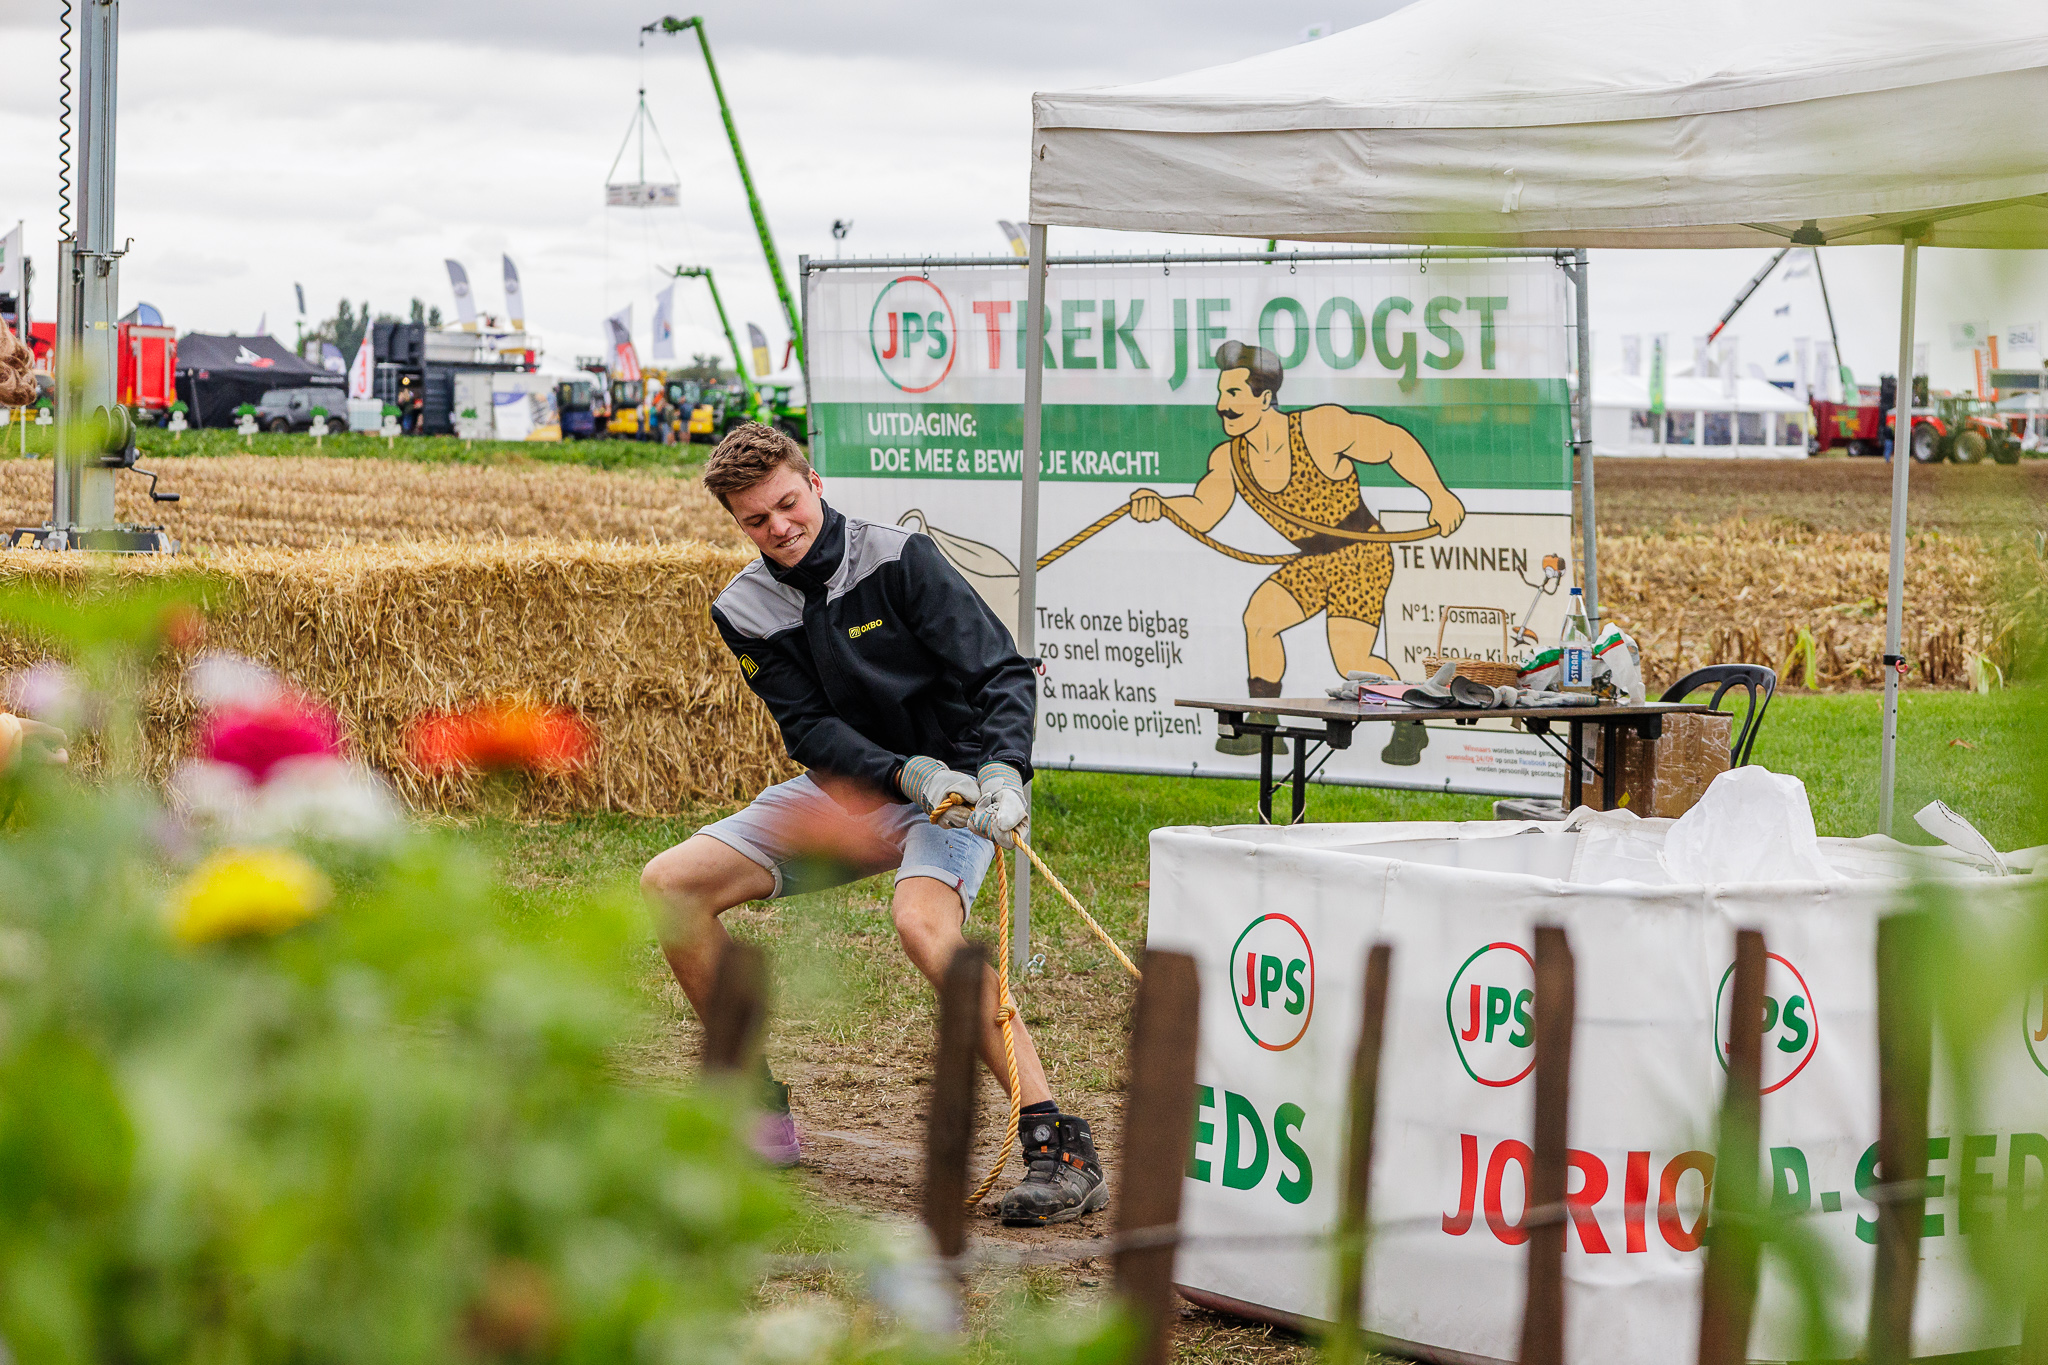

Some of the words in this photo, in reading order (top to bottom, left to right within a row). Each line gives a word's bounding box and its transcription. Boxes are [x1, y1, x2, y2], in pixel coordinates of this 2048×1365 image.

[882, 311, 948, 359] JPS
[973, 299, 1150, 369] TREK
[1168, 298, 1231, 392] JE
[1259, 296, 1508, 393] OOGST
[868, 412, 977, 437] UITDAGING:
[869, 447, 911, 472] DOE
[915, 448, 953, 472] MEE
[956, 449, 970, 473] &
[1046, 450, 1067, 474] JE
[1072, 450, 1160, 475] KRACHT!
[1399, 545, 1425, 569] TE
[1430, 546, 1528, 572] WINNEN
[861, 619, 882, 633] OXBO
[1036, 607, 1075, 630] Trek
[1080, 613, 1122, 632] onze
[1128, 609, 1189, 639] bigbag
[1040, 642, 1059, 659] zo
[1065, 638, 1099, 661] snel
[1105, 640, 1183, 669] mogelijk
[1571, 651, 1579, 679] STRAAL
[1043, 676, 1057, 699] &
[1062, 678, 1110, 701] maak
[1115, 679, 1157, 703] kans
[1046, 711, 1067, 732] op
[1073, 708, 1129, 731] mooie
[1135, 711, 1202, 738] prijzen!
[1242, 952, 1306, 1015] JPS
[1461, 984, 1536, 1048] JPS
[1185, 1082, 1313, 1204] EDS
